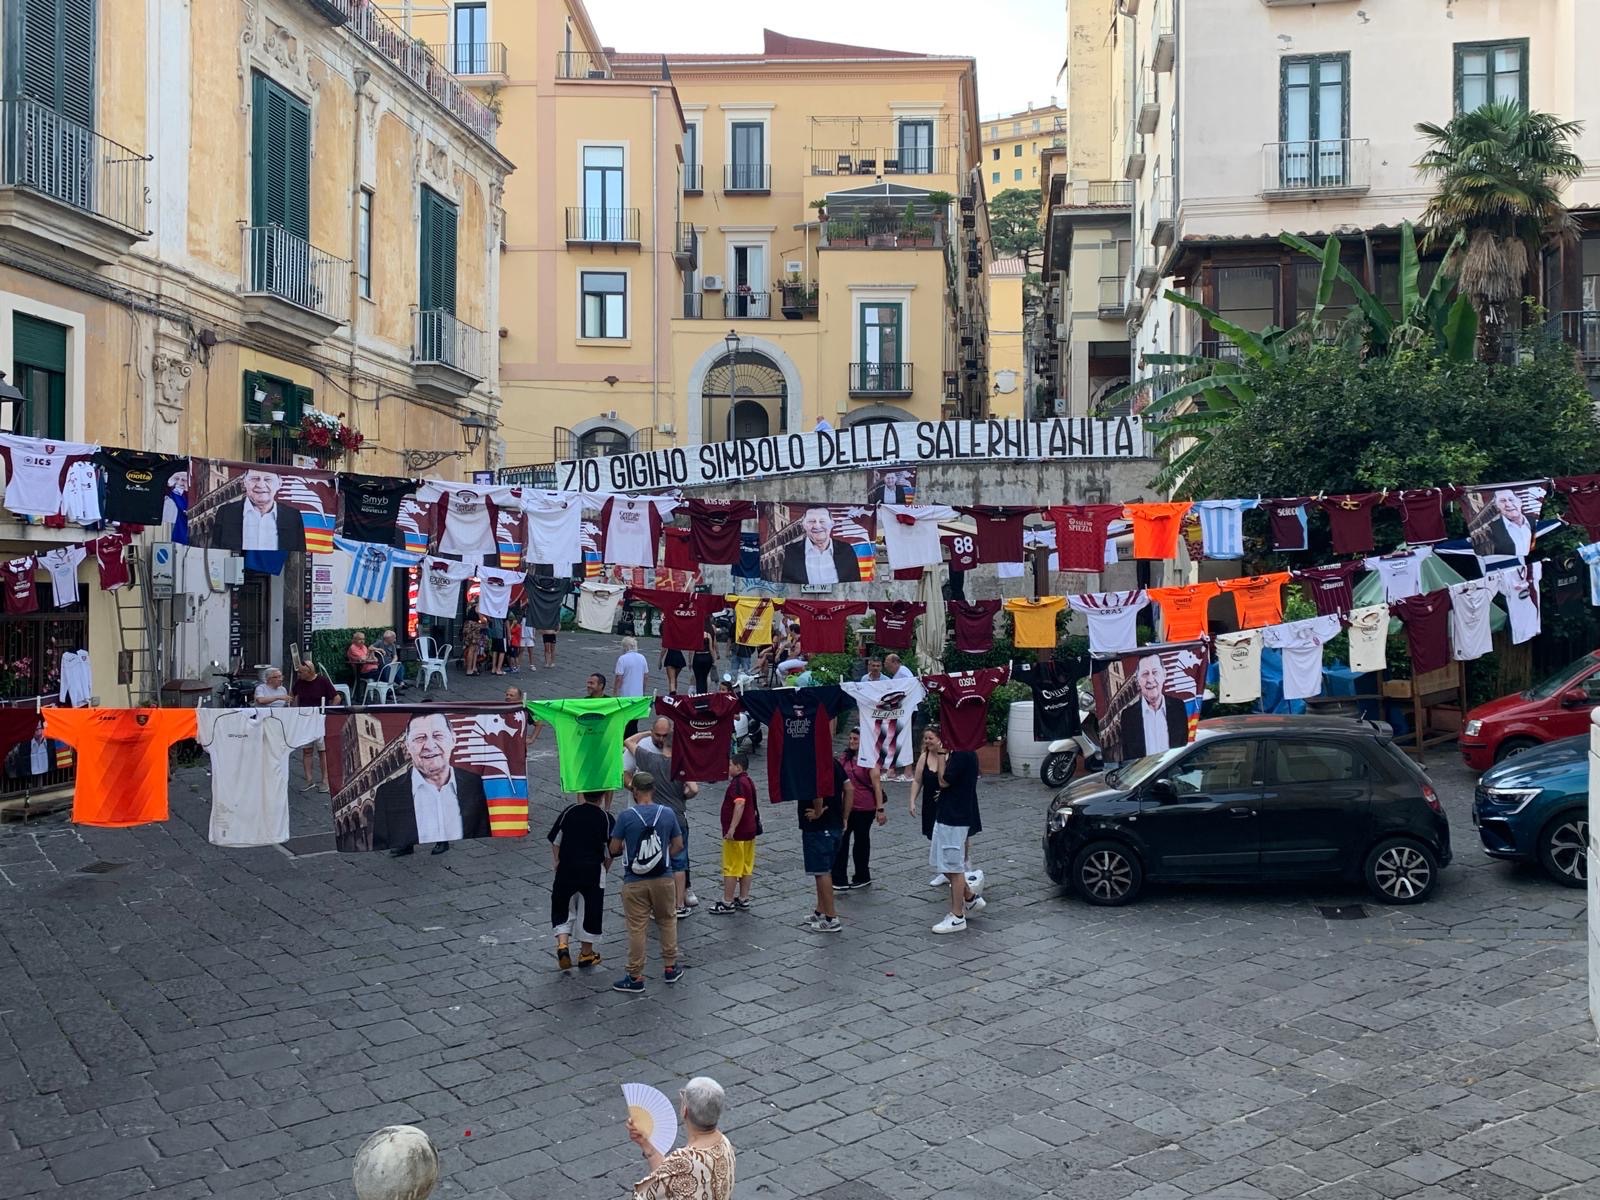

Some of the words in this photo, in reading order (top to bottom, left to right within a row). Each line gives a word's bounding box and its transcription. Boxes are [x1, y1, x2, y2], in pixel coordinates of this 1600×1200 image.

[34, 458, 52, 466] ICS
[560, 459, 600, 493] ZIO
[700, 433, 805, 480] SIMBOLO
[818, 421, 900, 467] DELLA
[362, 494, 389, 505] Smyb
[953, 536, 974, 555] 88
[785, 718, 811, 727] Centrale
